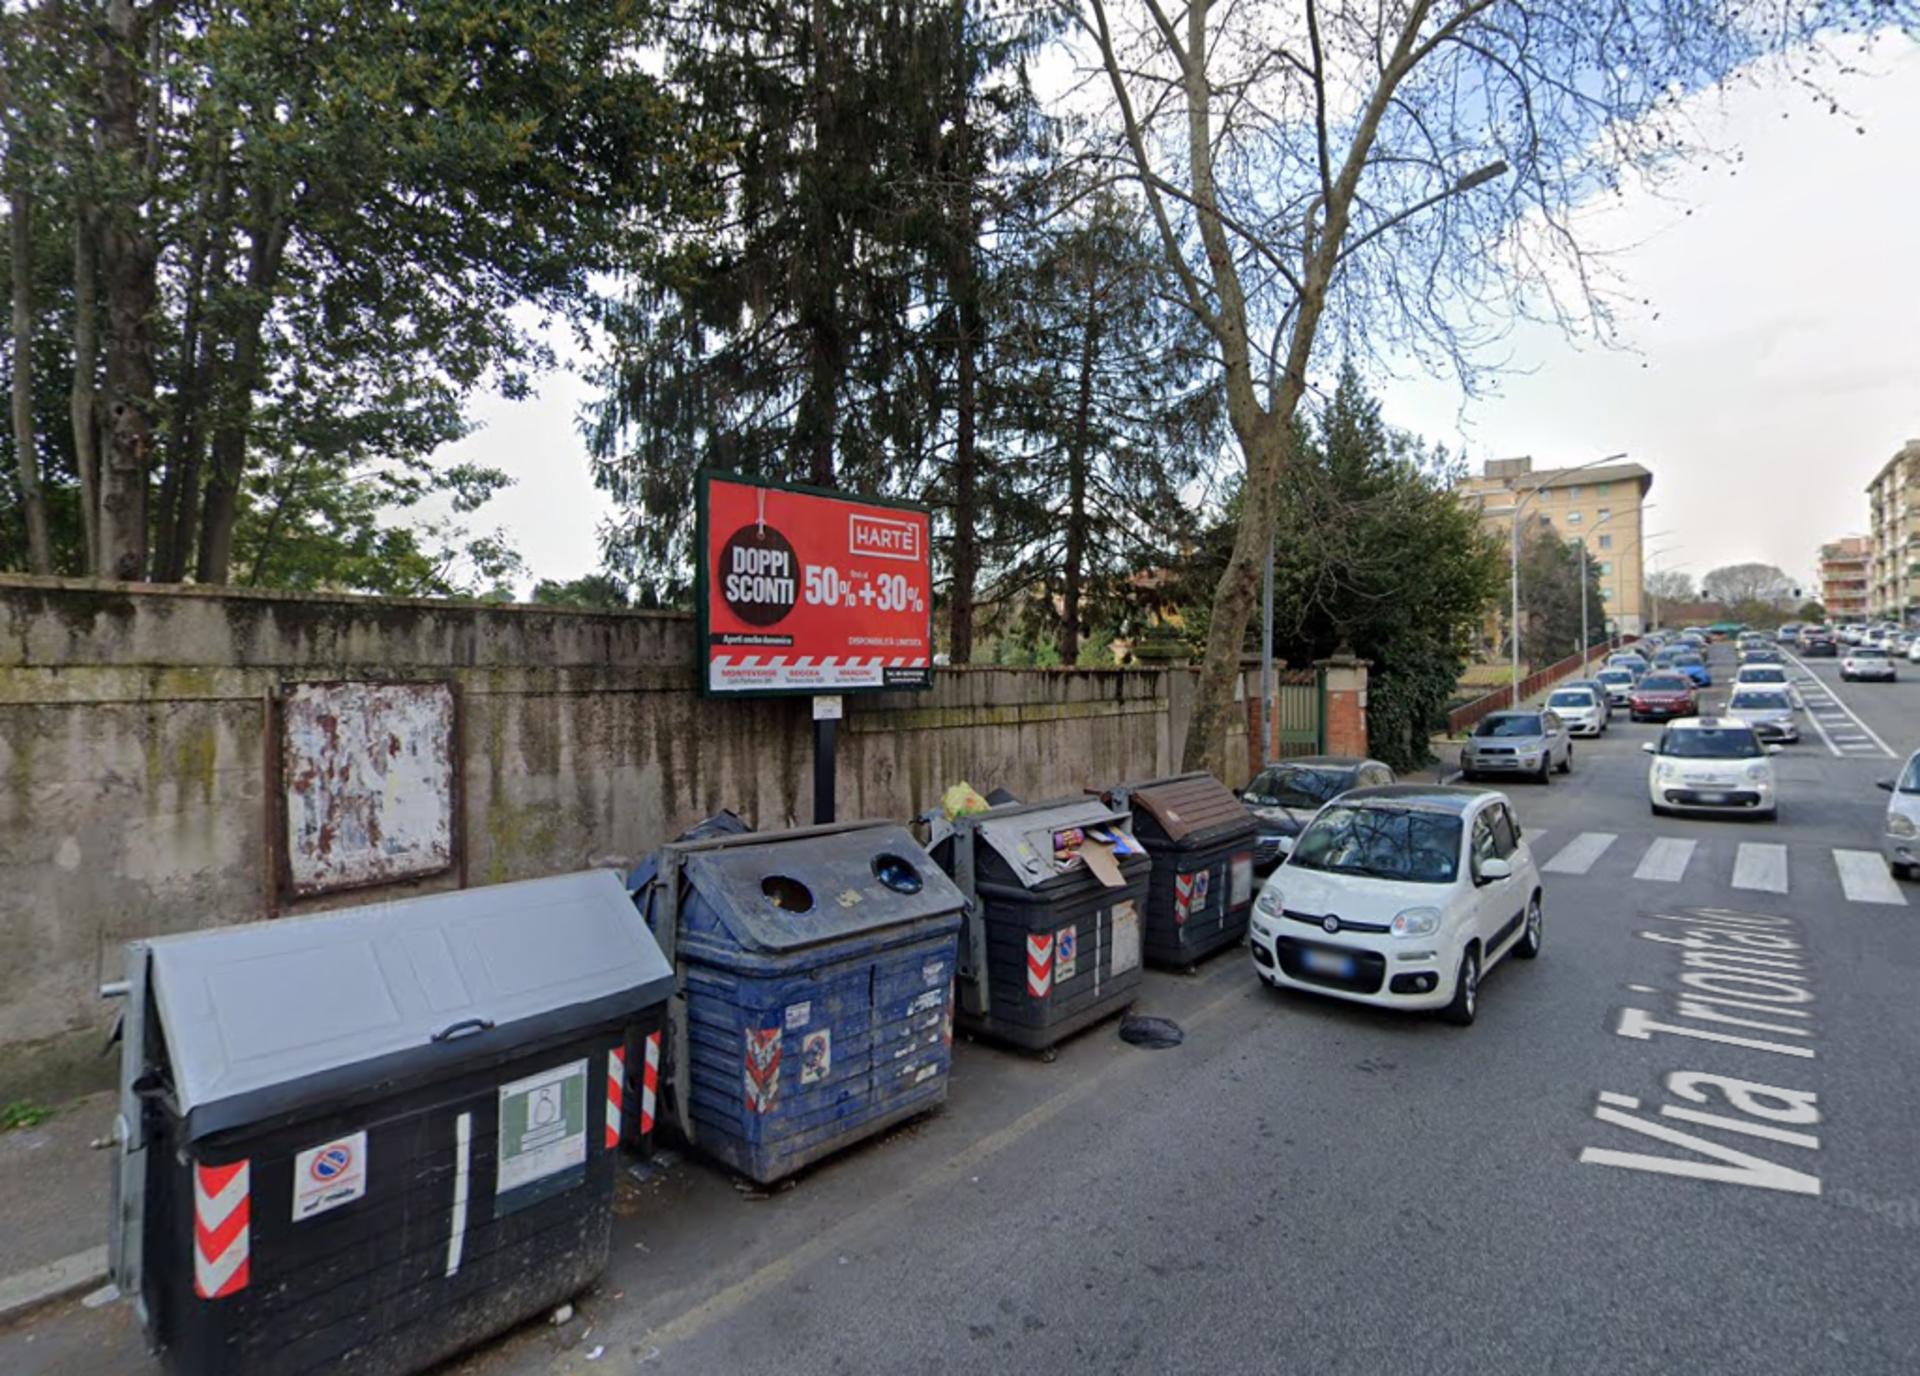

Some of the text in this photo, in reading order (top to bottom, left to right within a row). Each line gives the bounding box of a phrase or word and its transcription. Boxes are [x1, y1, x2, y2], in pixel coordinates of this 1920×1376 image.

[856, 523, 914, 551] HARTÈ
[732, 546, 789, 577] DOPPI
[726, 577, 795, 605] SCONTI
[1580, 1071, 1822, 1195] Via
